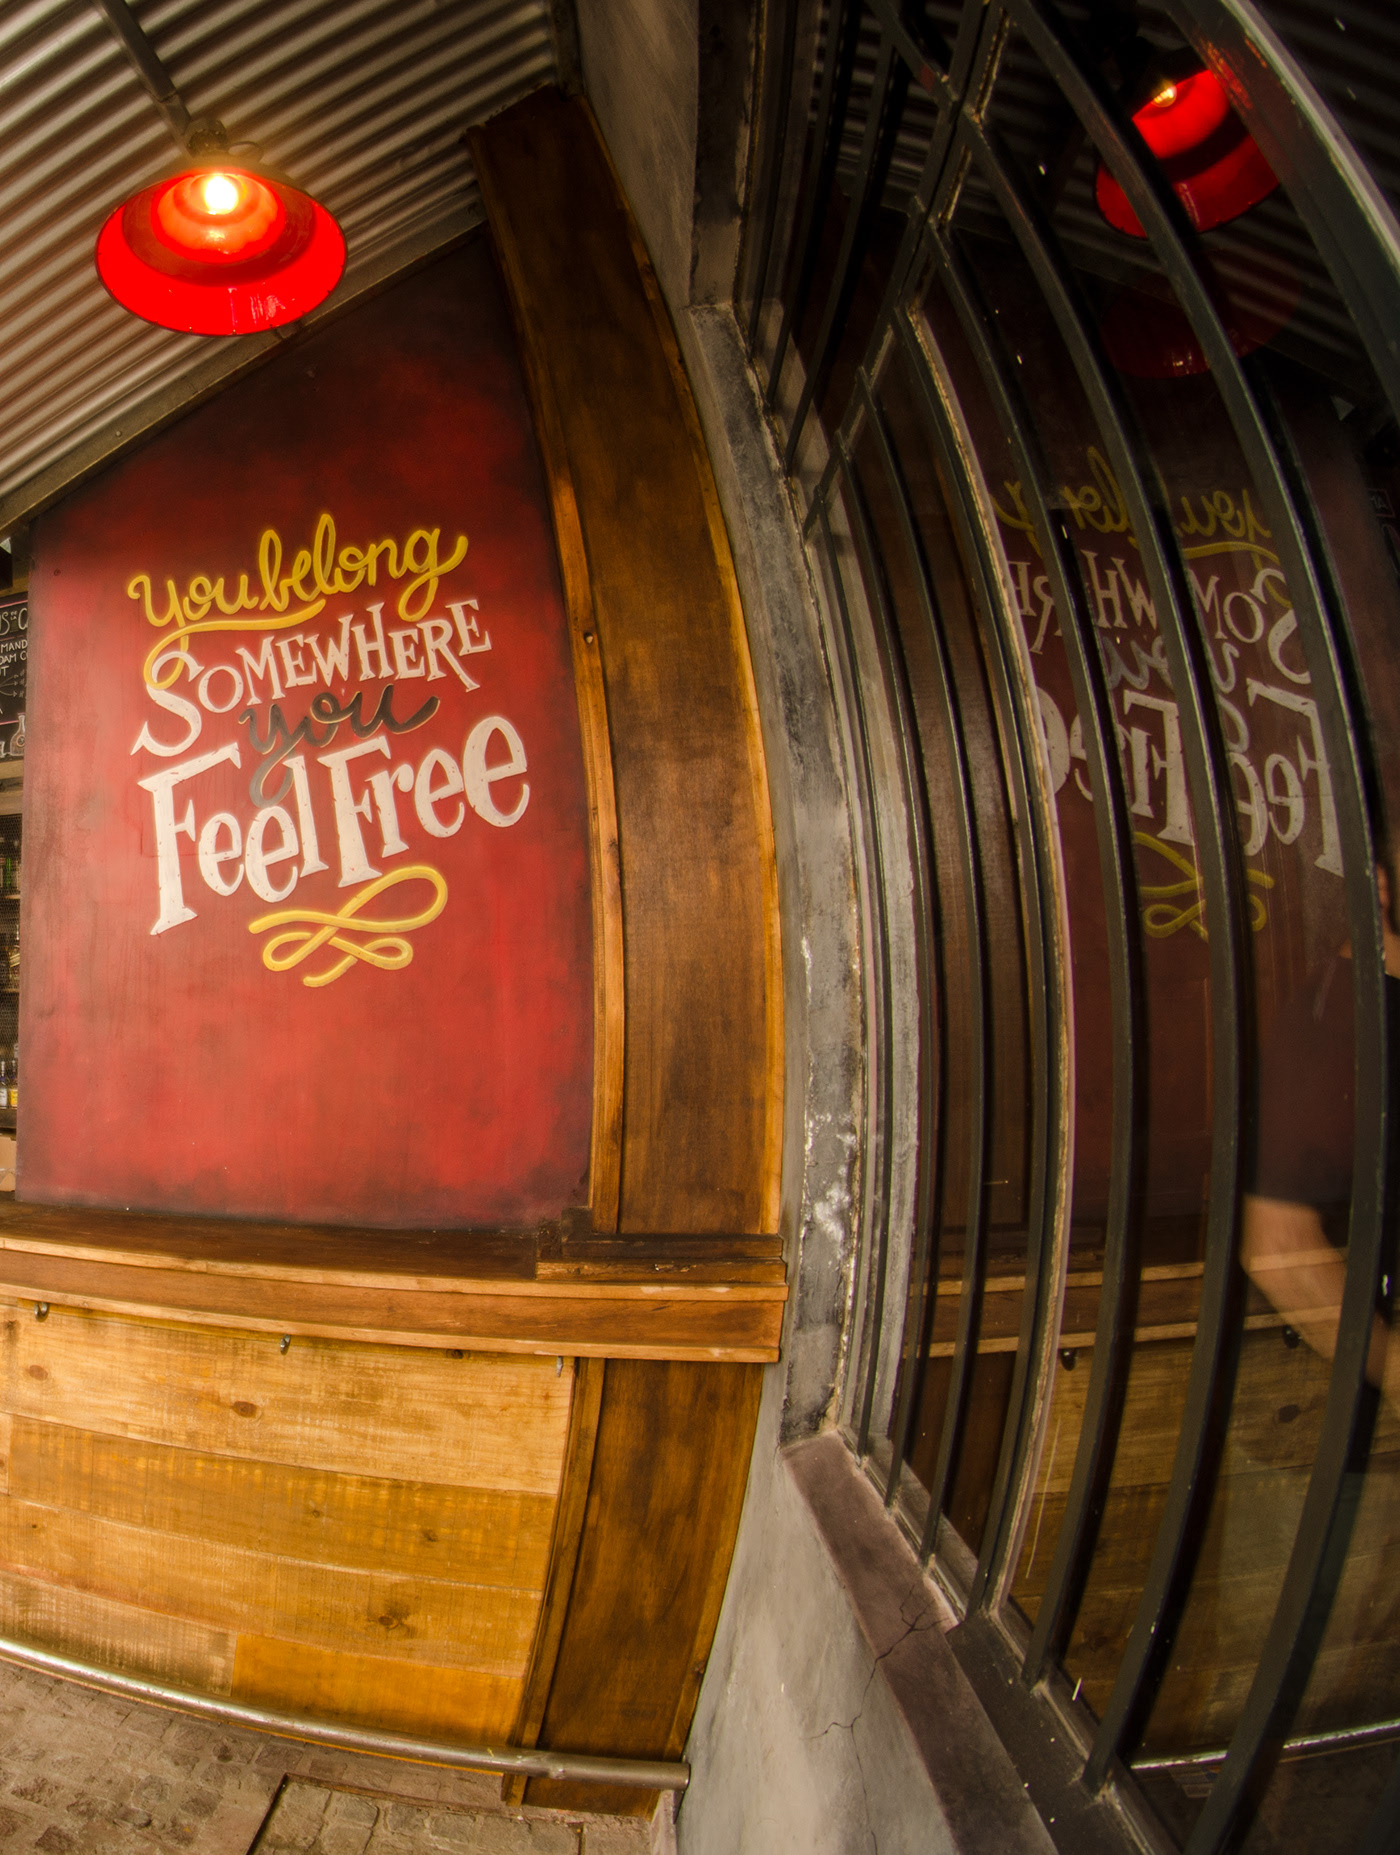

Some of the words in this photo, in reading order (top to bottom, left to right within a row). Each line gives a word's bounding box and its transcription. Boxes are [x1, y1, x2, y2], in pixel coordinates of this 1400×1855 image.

[130, 599, 492, 757] SOMEWHERE
[238, 684, 440, 808] you
[137, 742, 329, 936] Feel
[317, 716, 530, 887] Free
